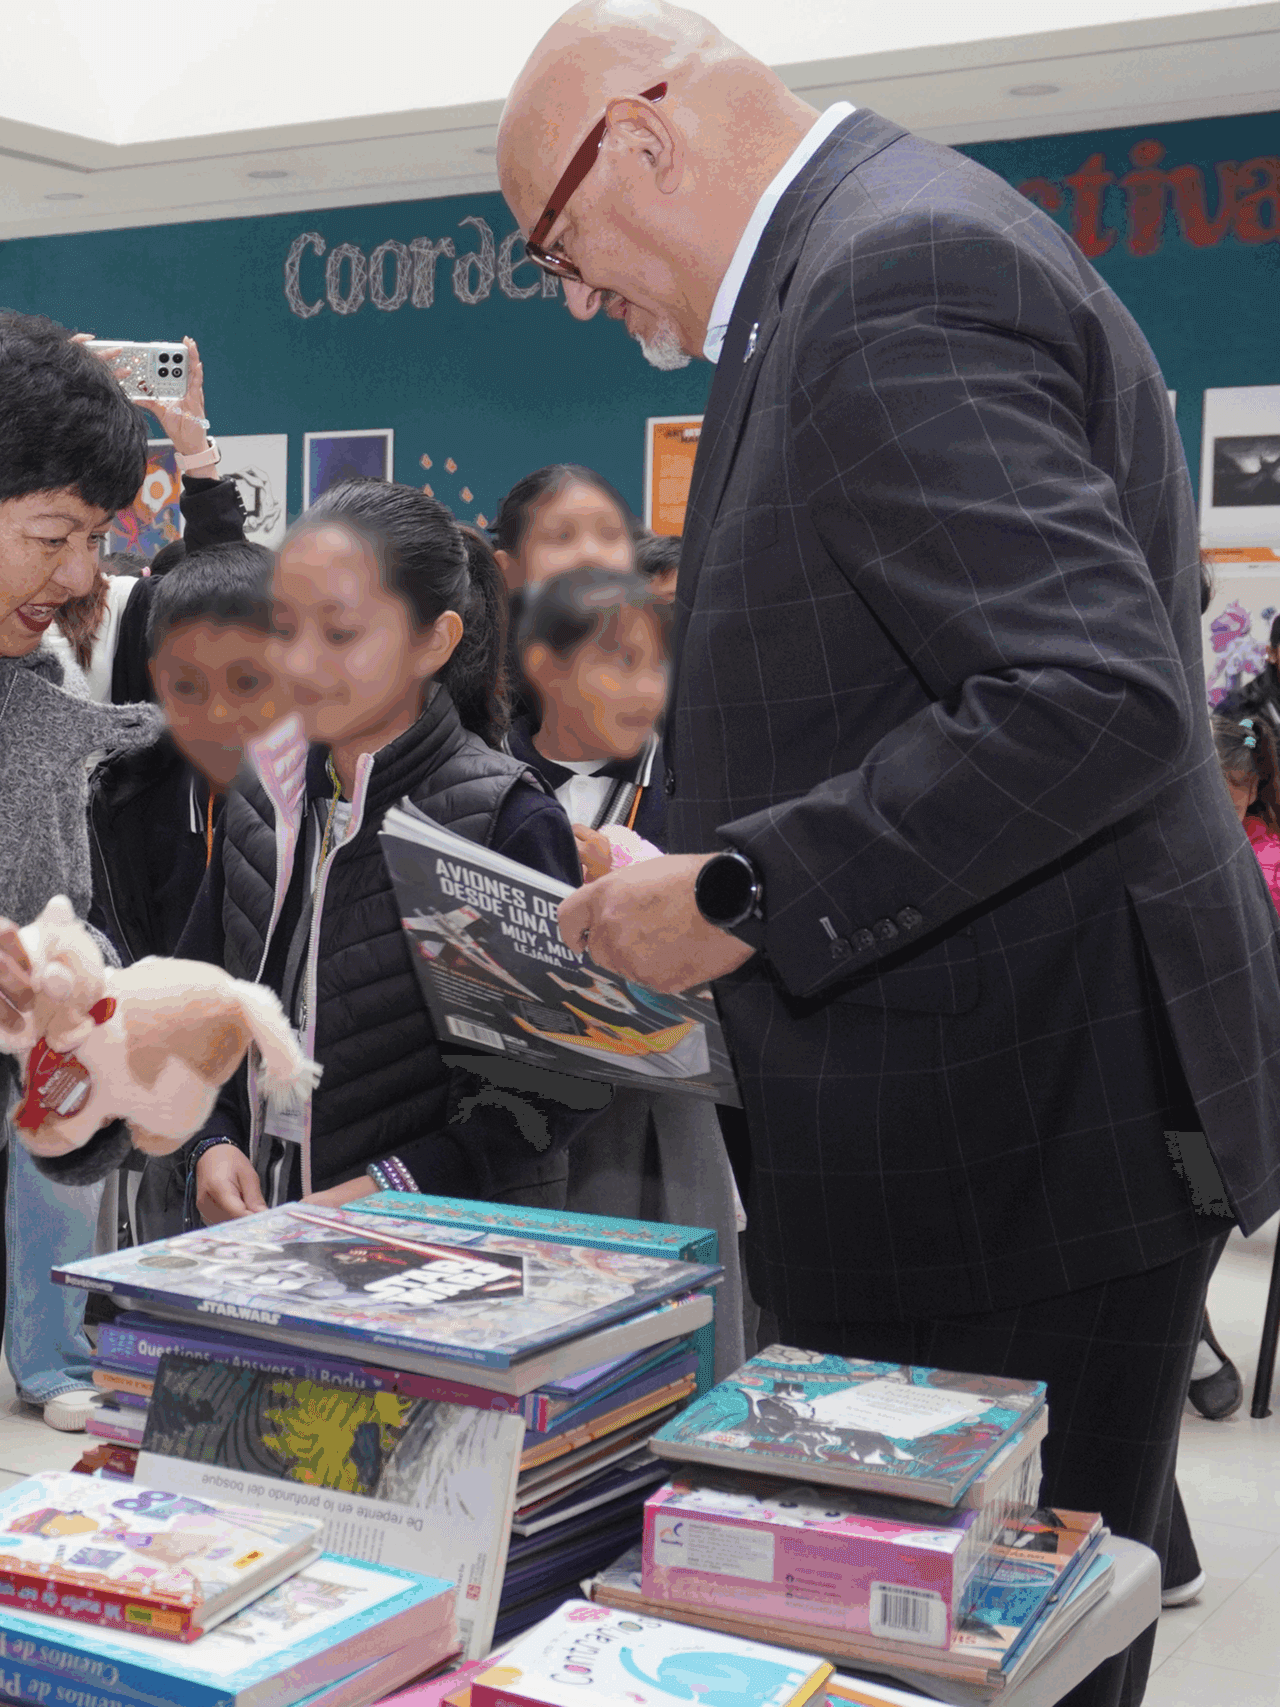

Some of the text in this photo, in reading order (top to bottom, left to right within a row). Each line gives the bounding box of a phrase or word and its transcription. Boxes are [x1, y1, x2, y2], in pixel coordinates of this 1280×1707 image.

[436, 858, 527, 909] AVIONES
[439, 877, 505, 918] DESDE
[508, 905, 552, 938] UNA
[546, 940, 584, 965] MUY
[363, 1259, 477, 1299] STAR
[383, 1262, 513, 1306] WARS
[201, 1473, 425, 1533] De repente en lo profundo del bosque
[11, 1638, 37, 1662] de
[40, 1645, 119, 1688] Cuentos
[26, 1678, 53, 1702] de
